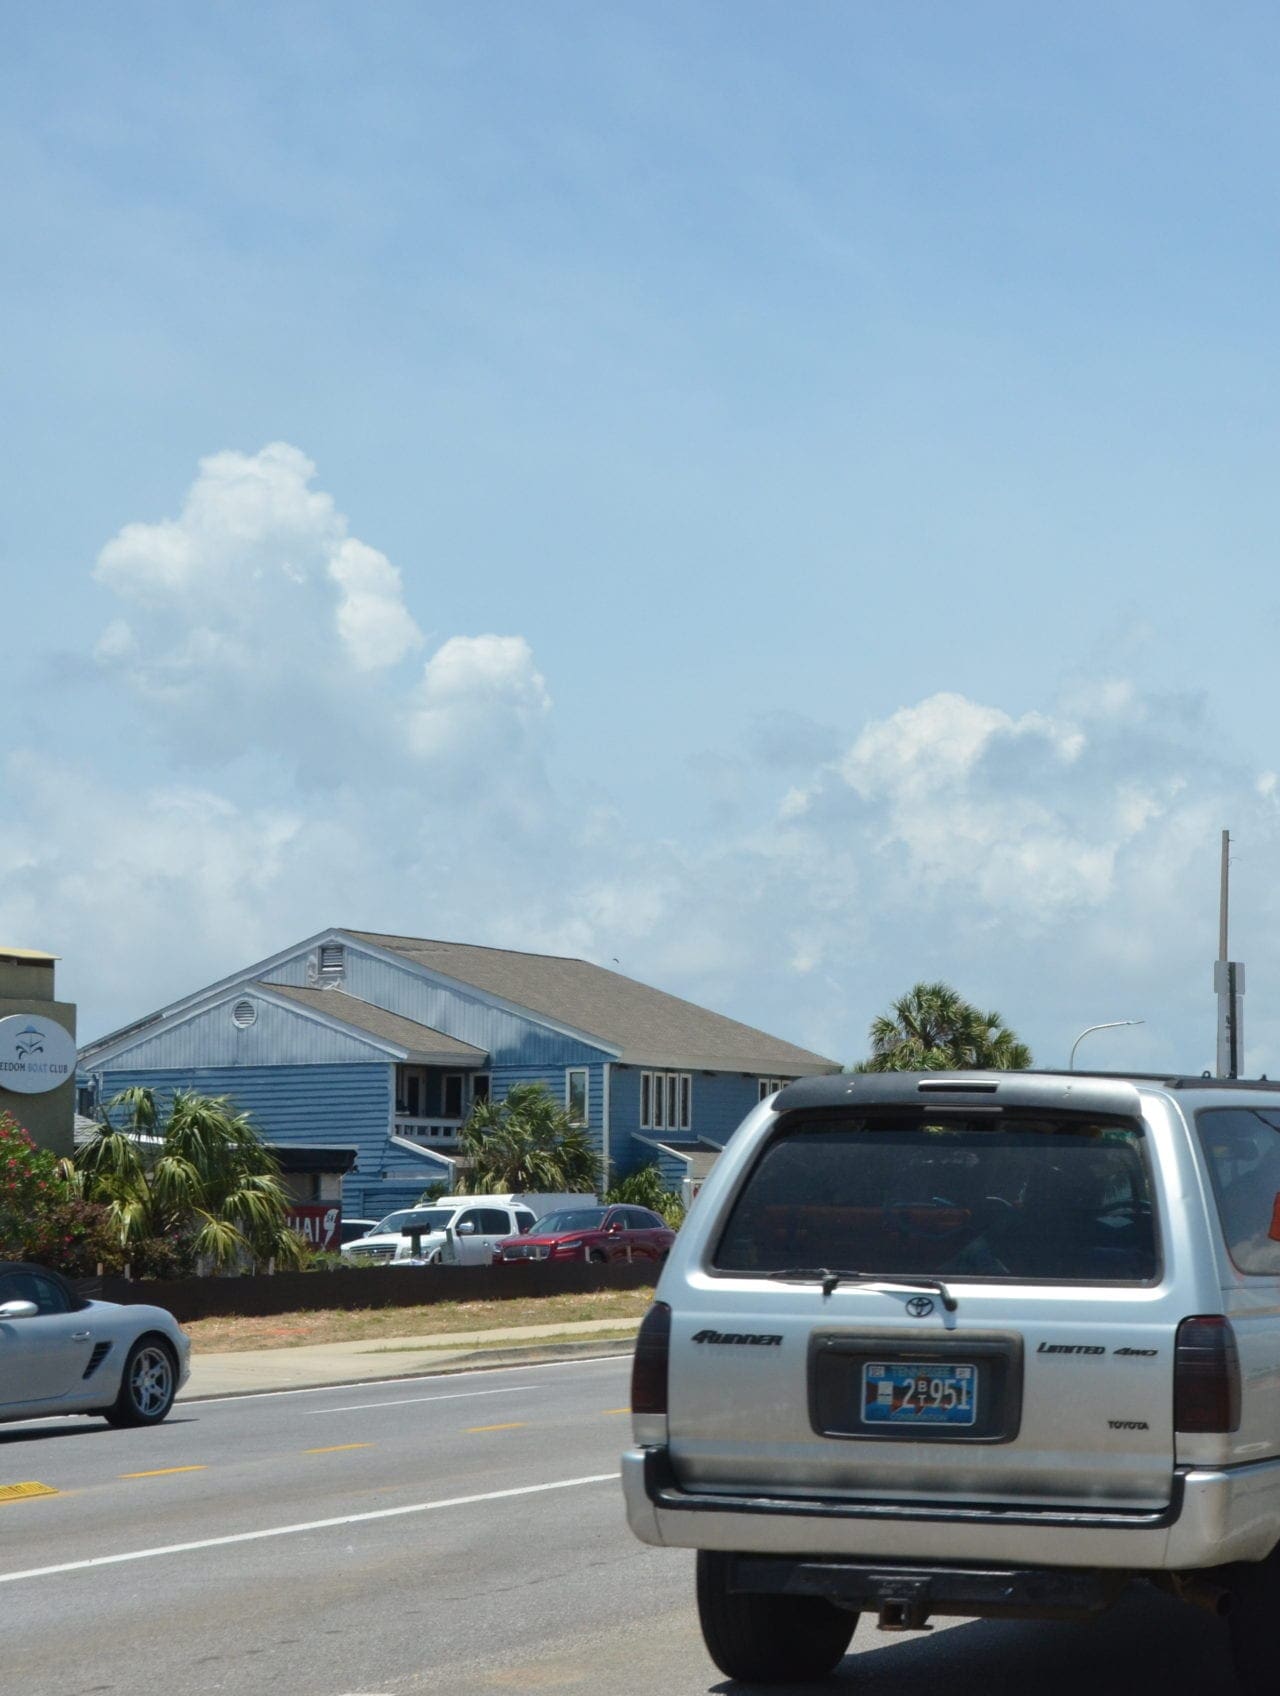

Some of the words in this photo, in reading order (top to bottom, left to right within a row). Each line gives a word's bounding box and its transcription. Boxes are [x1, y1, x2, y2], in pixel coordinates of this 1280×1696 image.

[28, 1063, 47, 1072] BOAT
[49, 1064, 68, 1073] CLUB
[1108, 1421, 1149, 1430] TOYOTA
